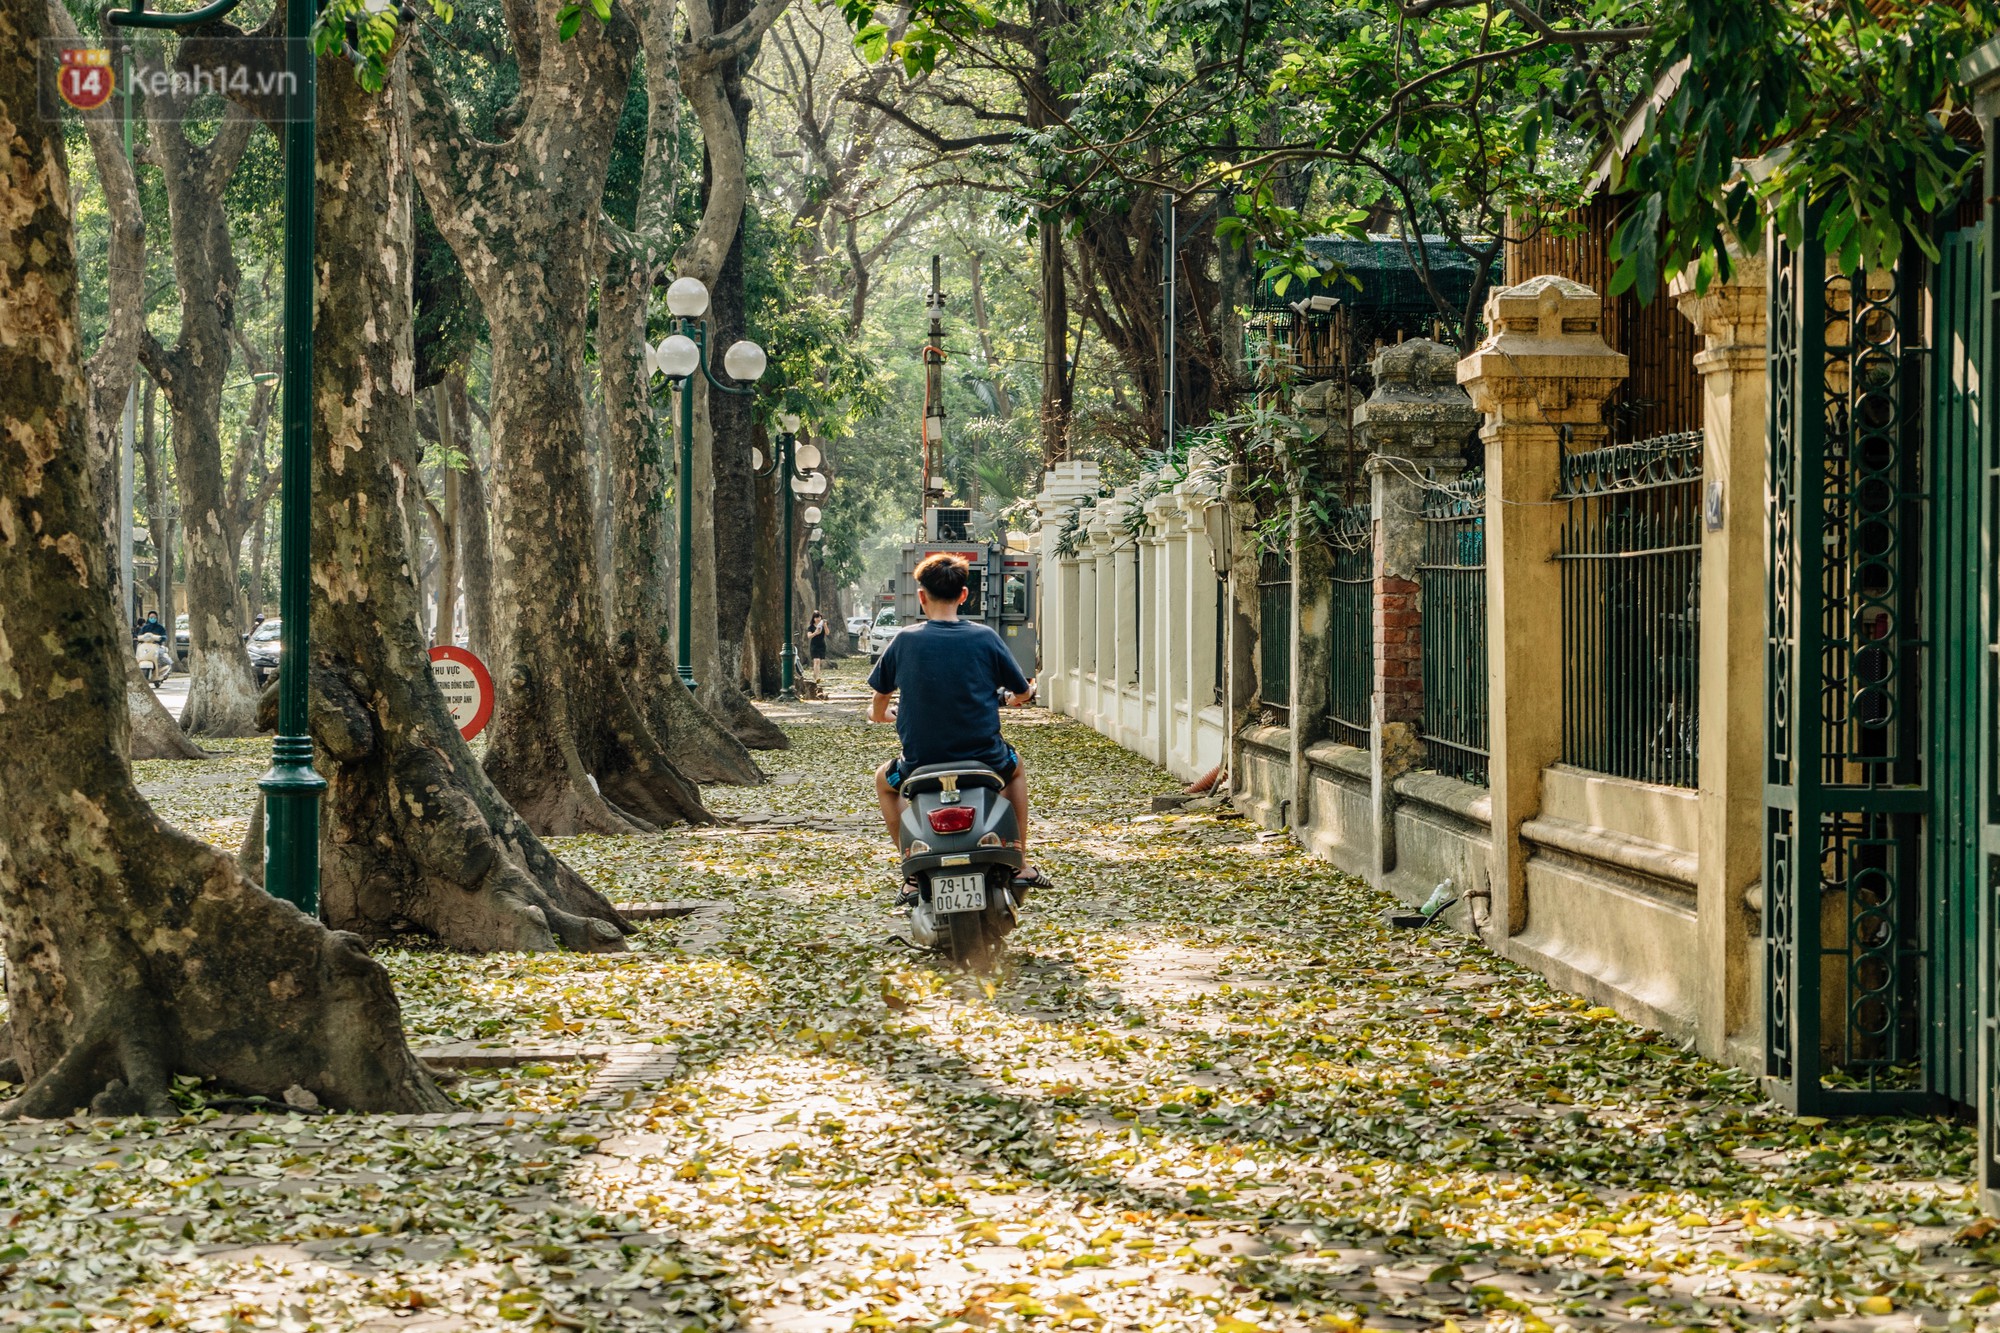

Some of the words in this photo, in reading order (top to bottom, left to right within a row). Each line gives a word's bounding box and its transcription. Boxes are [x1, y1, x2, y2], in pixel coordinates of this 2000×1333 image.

[447, 666, 460, 677] VỰC
[940, 876, 976, 894] 29-L1
[937, 892, 982, 911] 004.29
